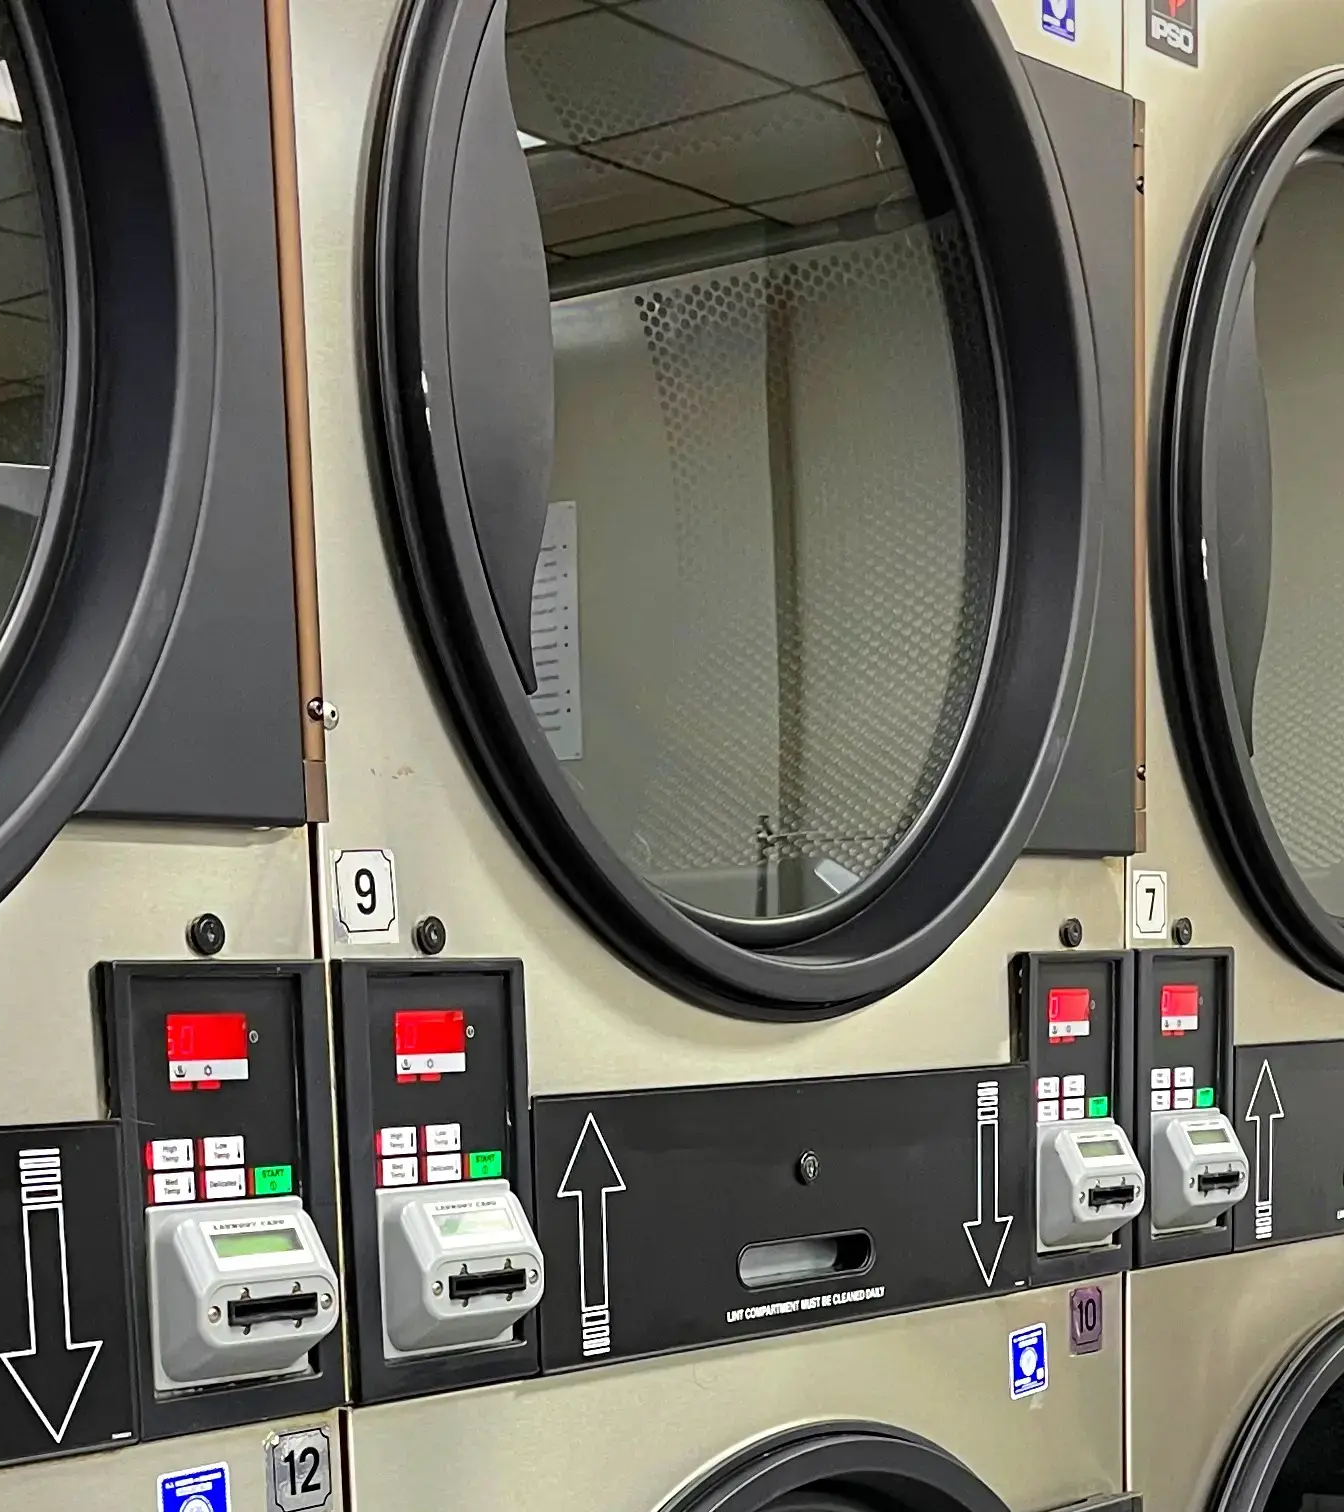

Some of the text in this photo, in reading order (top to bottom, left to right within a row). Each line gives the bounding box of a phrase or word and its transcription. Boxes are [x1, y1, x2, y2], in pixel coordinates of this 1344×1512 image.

[1151, 14, 1193, 54] IPSO
[355, 868, 376, 915] 9
[1145, 888, 1156, 921] 7
[261, 1168, 285, 1179] START
[727, 1308, 744, 1322] LINT
[1078, 1298, 1097, 1334] 10
[284, 1446, 321, 1496] 12
